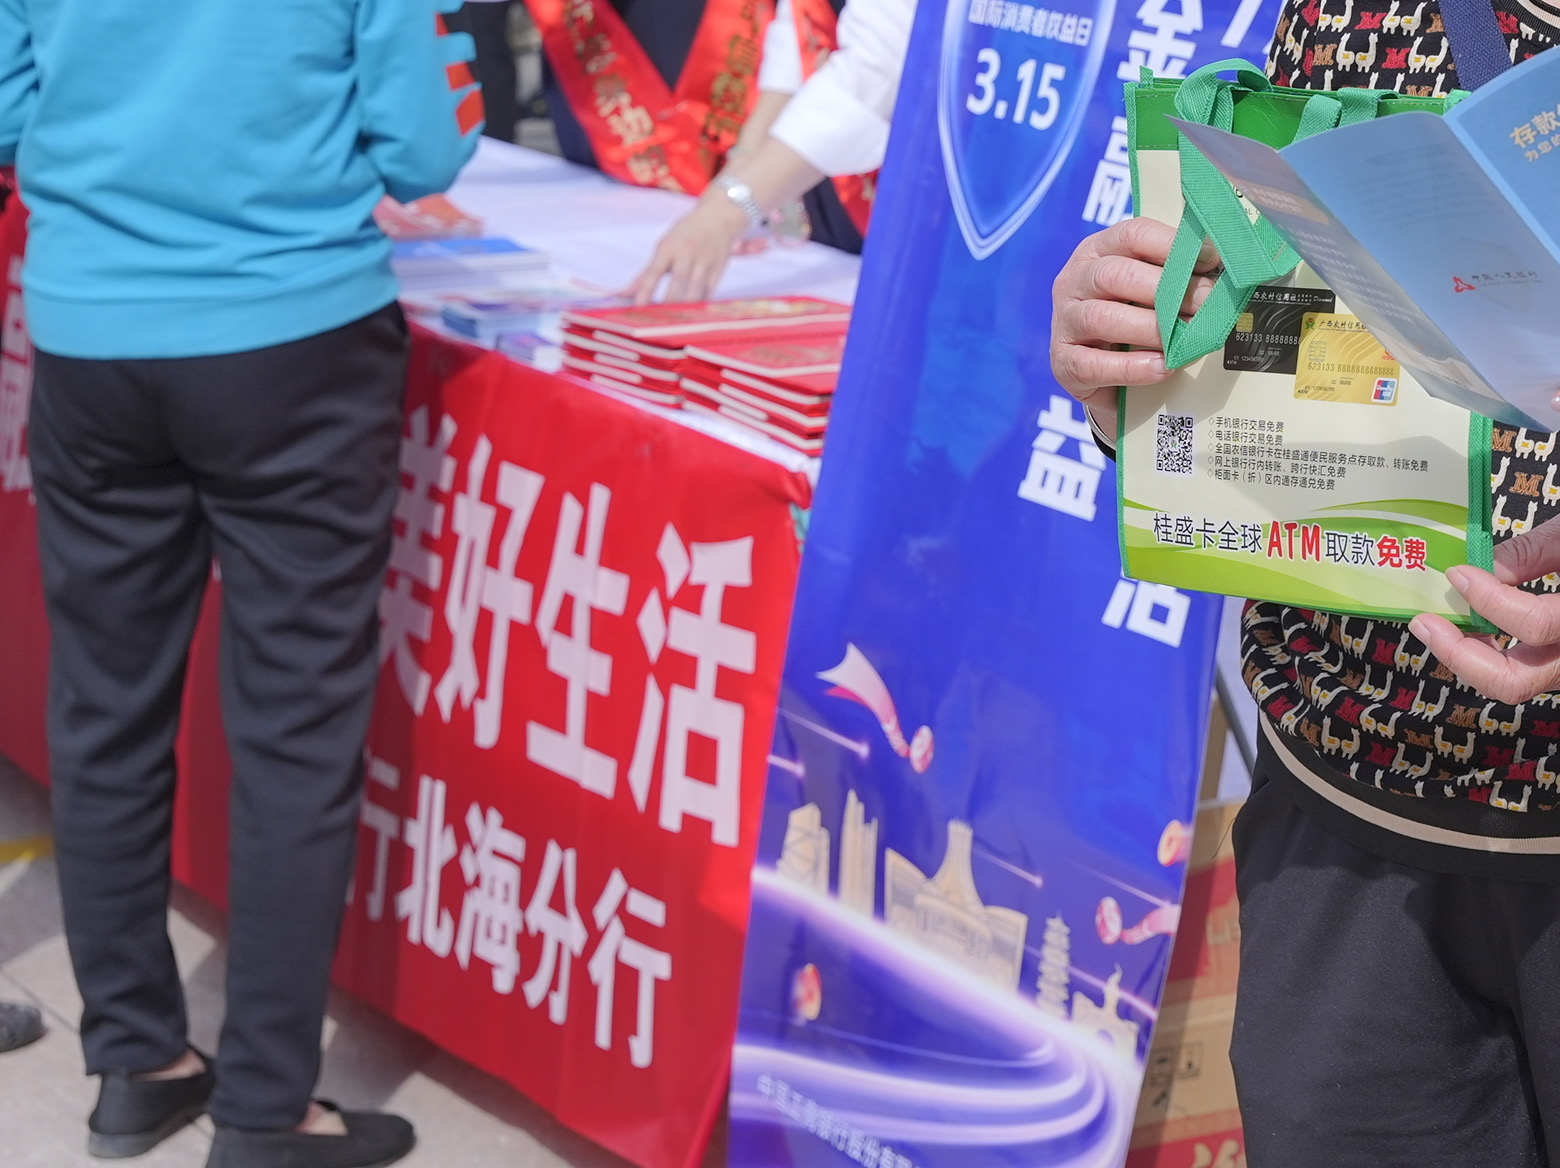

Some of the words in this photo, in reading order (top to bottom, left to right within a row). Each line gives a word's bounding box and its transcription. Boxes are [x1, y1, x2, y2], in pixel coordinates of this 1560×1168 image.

[1358, 13, 1385, 28] M
[1312, 45, 1336, 64] M
[1384, 49, 1409, 67] M
[966, 47, 1066, 131] 3.15
[1235, 333, 1263, 343] 623133
[1307, 362, 1335, 372] 623133
[1215, 417, 1284, 433] 手机银行交易免费
[1215, 430, 1283, 446] 电话银行交易免费
[1492, 429, 1515, 451] M
[1214, 456, 1347, 478] 网上银行行内转账、跨行快汇免费
[1215, 443, 1429, 472] 全国农信银行卡在桂盛通便民服务点存取款、转账免费
[1511, 473, 1544, 496] M
[1153, 512, 1427, 572] 桂盛卡全球ATM取款免费
[379, 405, 756, 848] 美好生活
[1375, 641, 1394, 663] M
[1338, 699, 1363, 723] M
[1448, 706, 1477, 727] M
[347, 746, 672, 1068] 行北海分行
